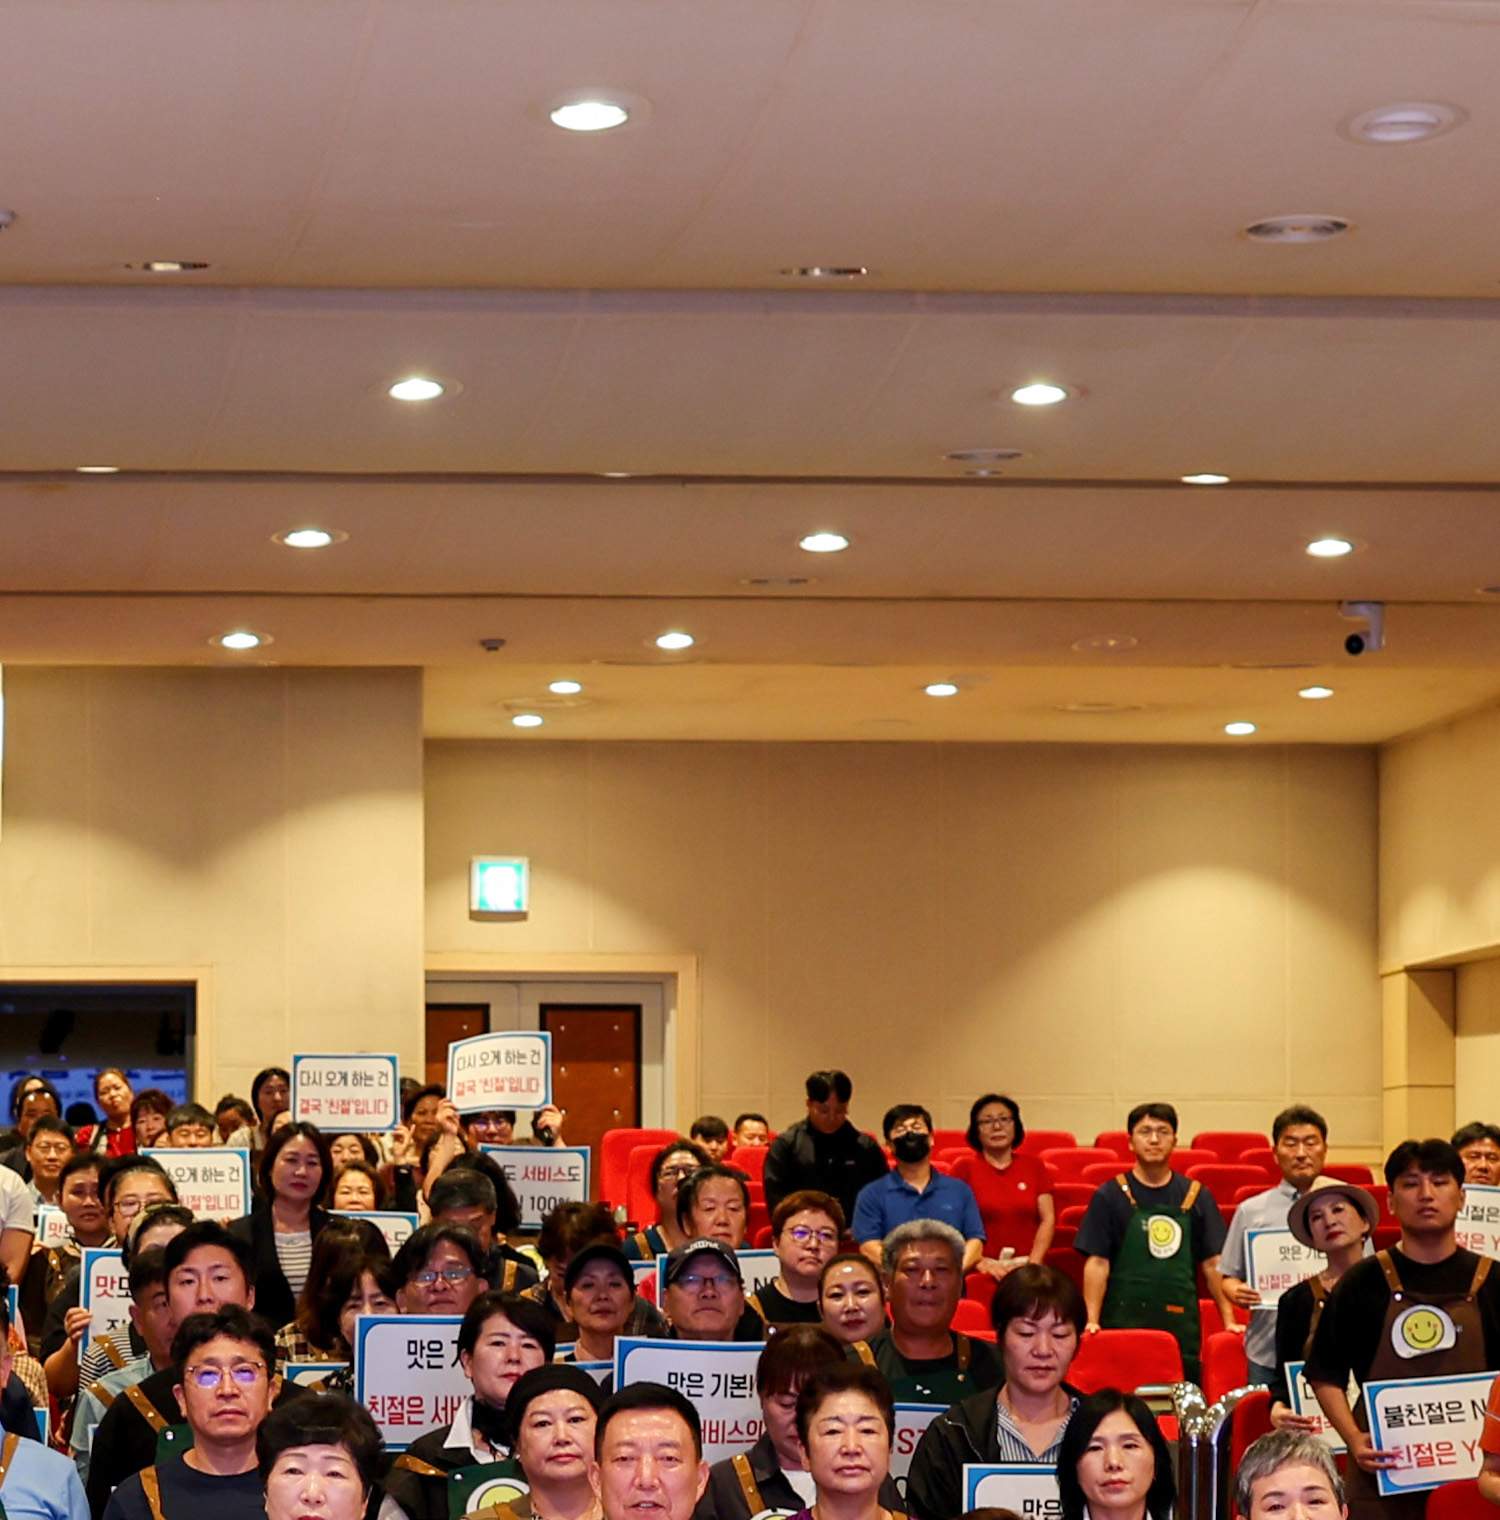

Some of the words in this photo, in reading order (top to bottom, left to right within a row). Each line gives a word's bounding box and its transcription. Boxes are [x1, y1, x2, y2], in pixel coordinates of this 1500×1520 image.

[457, 1055, 476, 1071] 다시
[480, 1050, 501, 1067] 오게
[505, 1050, 527, 1065] 하는
[531, 1049, 540, 1065] 건
[300, 1071, 322, 1086] 다시
[326, 1071, 348, 1086] 오게
[352, 1071, 374, 1087] 하는
[378, 1071, 388, 1086] 건
[456, 1080, 476, 1097] 결국
[300, 1099, 321, 1114] 결국
[325, 1099, 388, 1115] '친절'입니다
[174, 1165, 199, 1183] 오게
[201, 1167, 225, 1183] 하는
[229, 1167, 239, 1182] 건
[521, 1166, 580, 1182] 서비스도
[1278, 1243, 1304, 1262] 맛은
[1258, 1274, 1292, 1291] 친절은
[408, 1340, 444, 1369] 맛은
[711, 1374, 754, 1398] 기본!
[371, 1396, 424, 1425] 친절은
[1384, 1401, 1465, 1429] 불친절은
